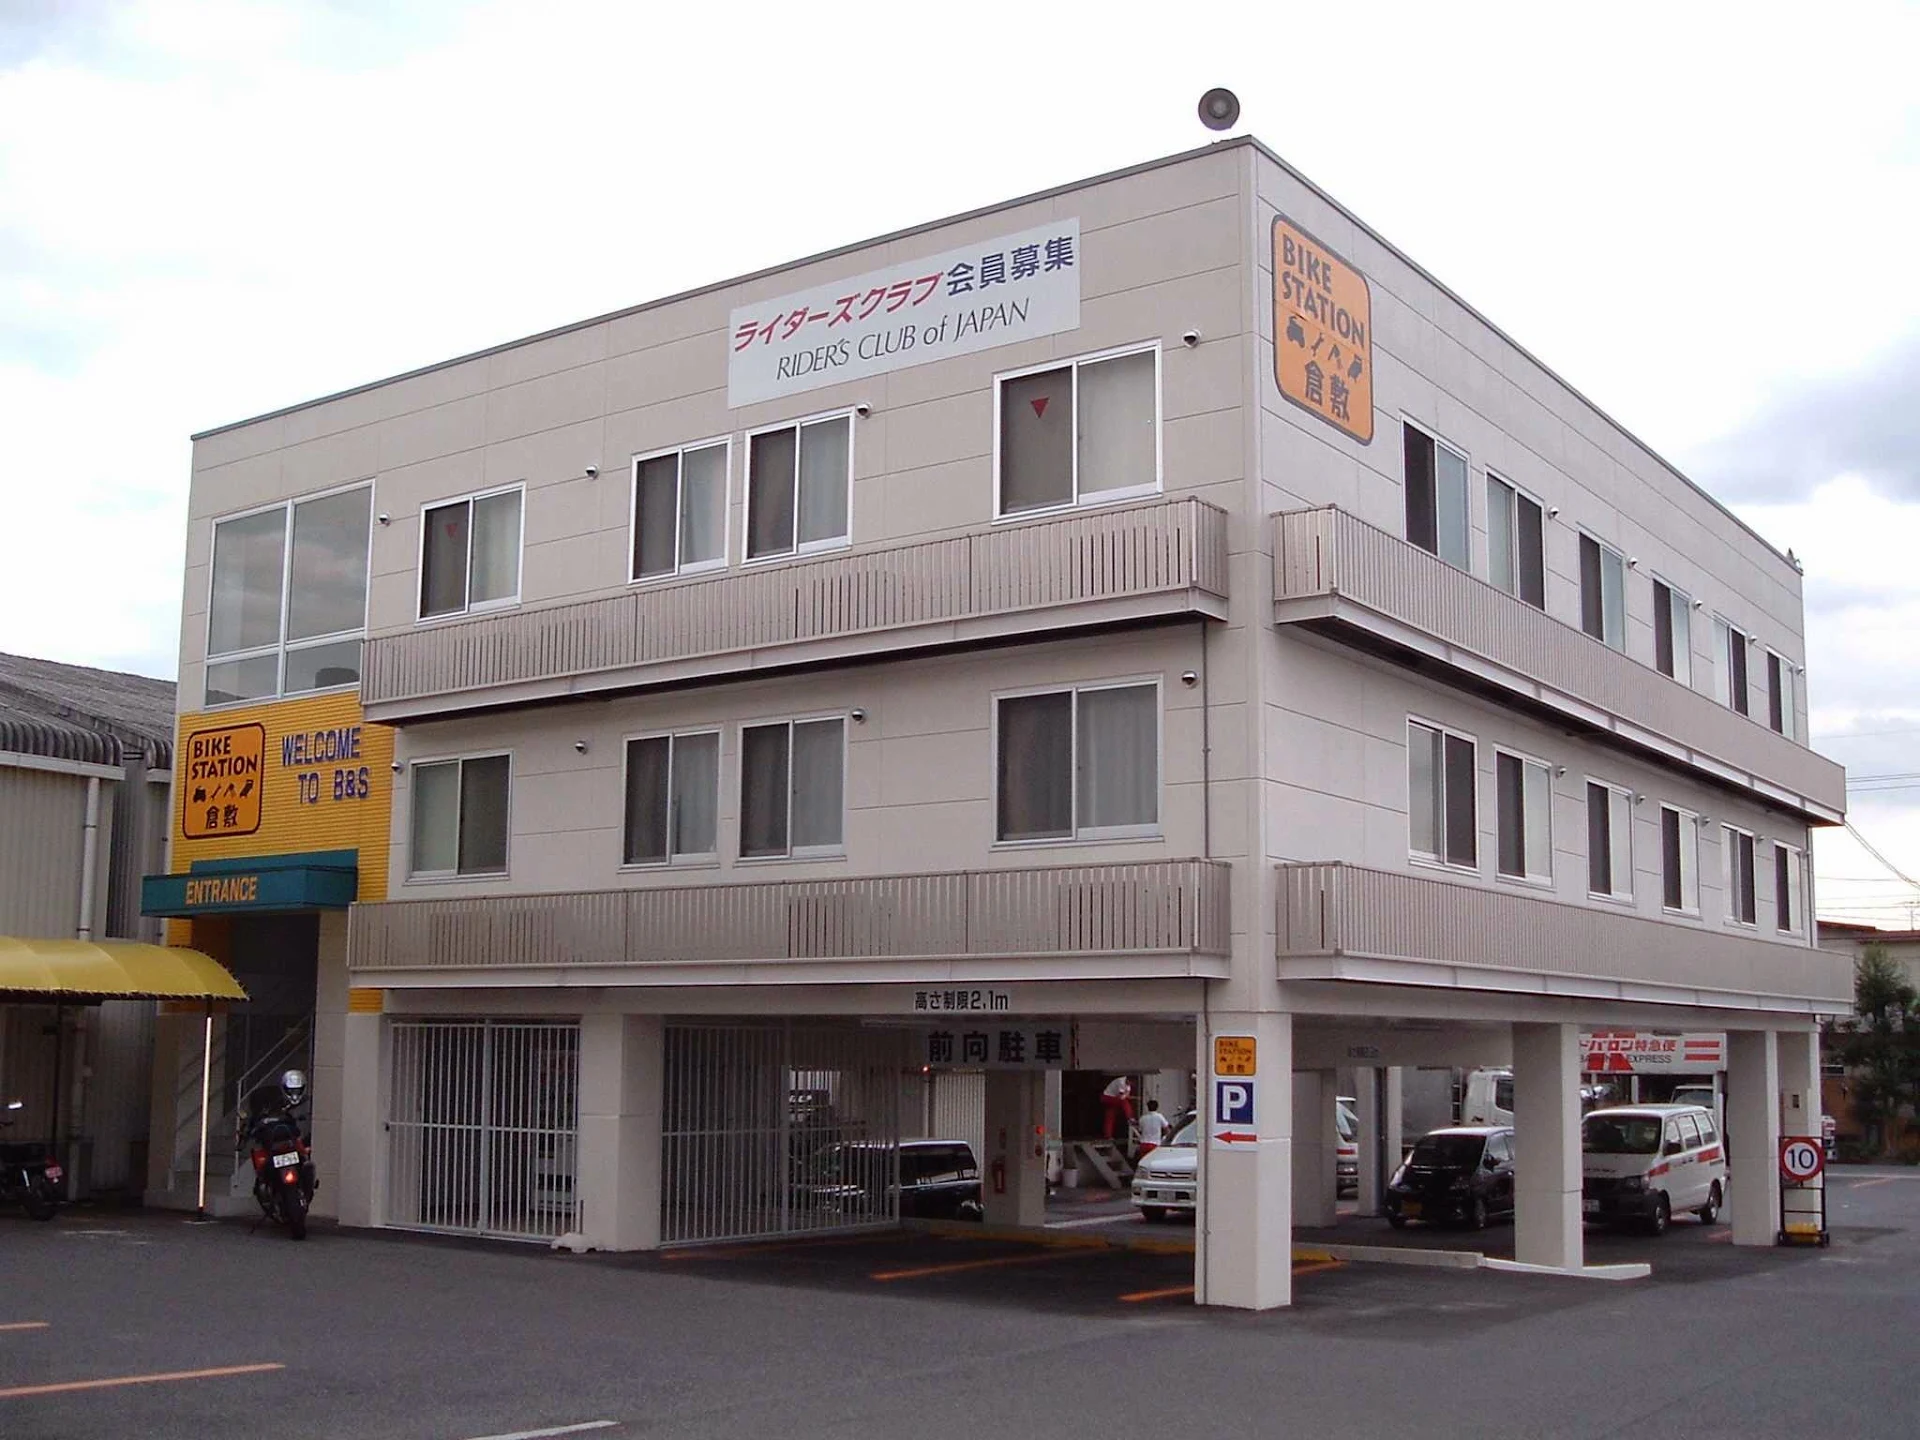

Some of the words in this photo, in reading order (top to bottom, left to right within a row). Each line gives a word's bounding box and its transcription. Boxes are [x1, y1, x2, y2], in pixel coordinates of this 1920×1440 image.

[1282, 234, 1332, 294] BIKE
[734, 236, 1075, 352] ライダーズクラブ会員募集
[1282, 271, 1365, 349] STATION
[776, 338, 850, 380] RIDER'S
[858, 325, 916, 361] CLUB
[923, 314, 946, 345] of
[953, 298, 1029, 342] JAPAN
[1304, 360, 1350, 422] 倉敷
[194, 736, 231, 759] BIKE
[282, 727, 361, 767] WELCOME
[191, 754, 258, 780] STATION
[298, 773, 319, 803] TO
[333, 767, 369, 801] B&S
[205, 804, 239, 830] 倉敷
[185, 876, 258, 905] ENTRANCE
[914, 990, 1009, 1010] 高さ制限2.1m
[928, 1030, 1062, 1063] 前向駐車
[1629, 1054, 1673, 1064] EXPRESS
[1222, 1085, 1247, 1120] P
[1788, 1149, 1814, 1169] 10
